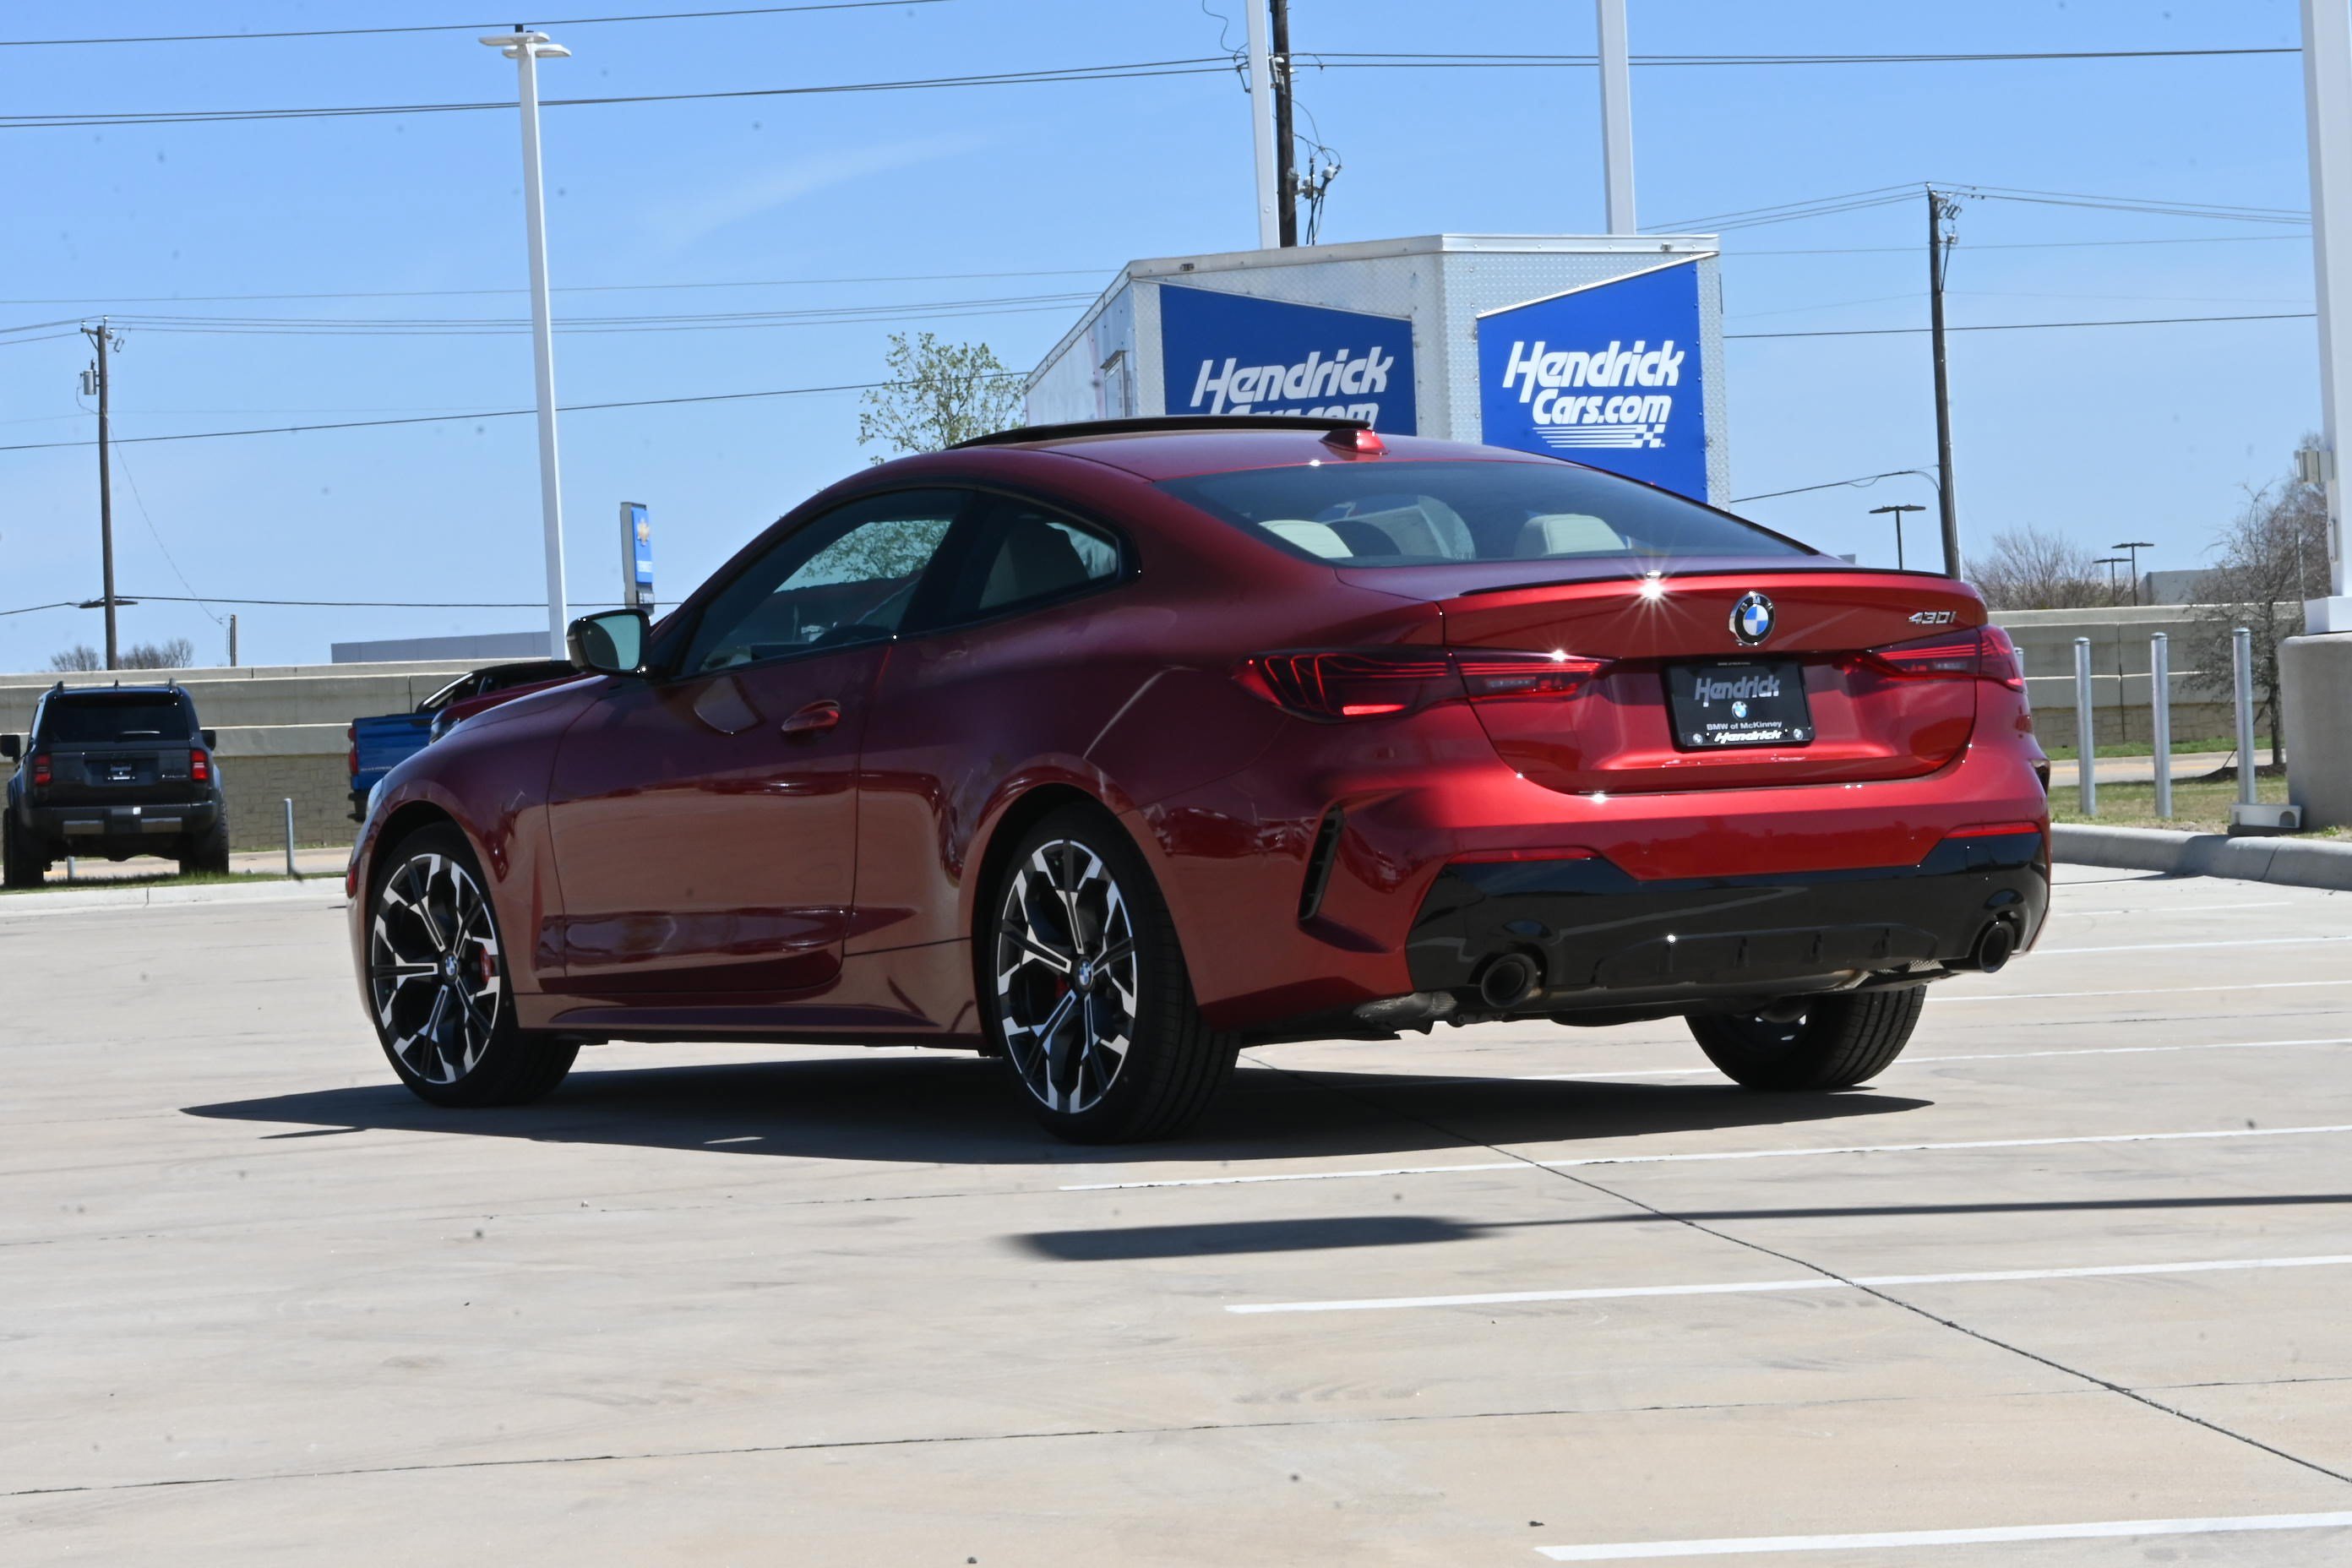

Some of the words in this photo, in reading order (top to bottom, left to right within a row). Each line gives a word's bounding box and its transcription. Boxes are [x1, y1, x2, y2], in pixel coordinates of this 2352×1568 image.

[1190, 346, 1395, 416] Hendrick
[1501, 340, 1685, 404] Hendrick
[1532, 388, 1673, 425] Cars.com
[1694, 674, 1781, 708] Hendrick
[1713, 730, 1782, 744] Hendrick
